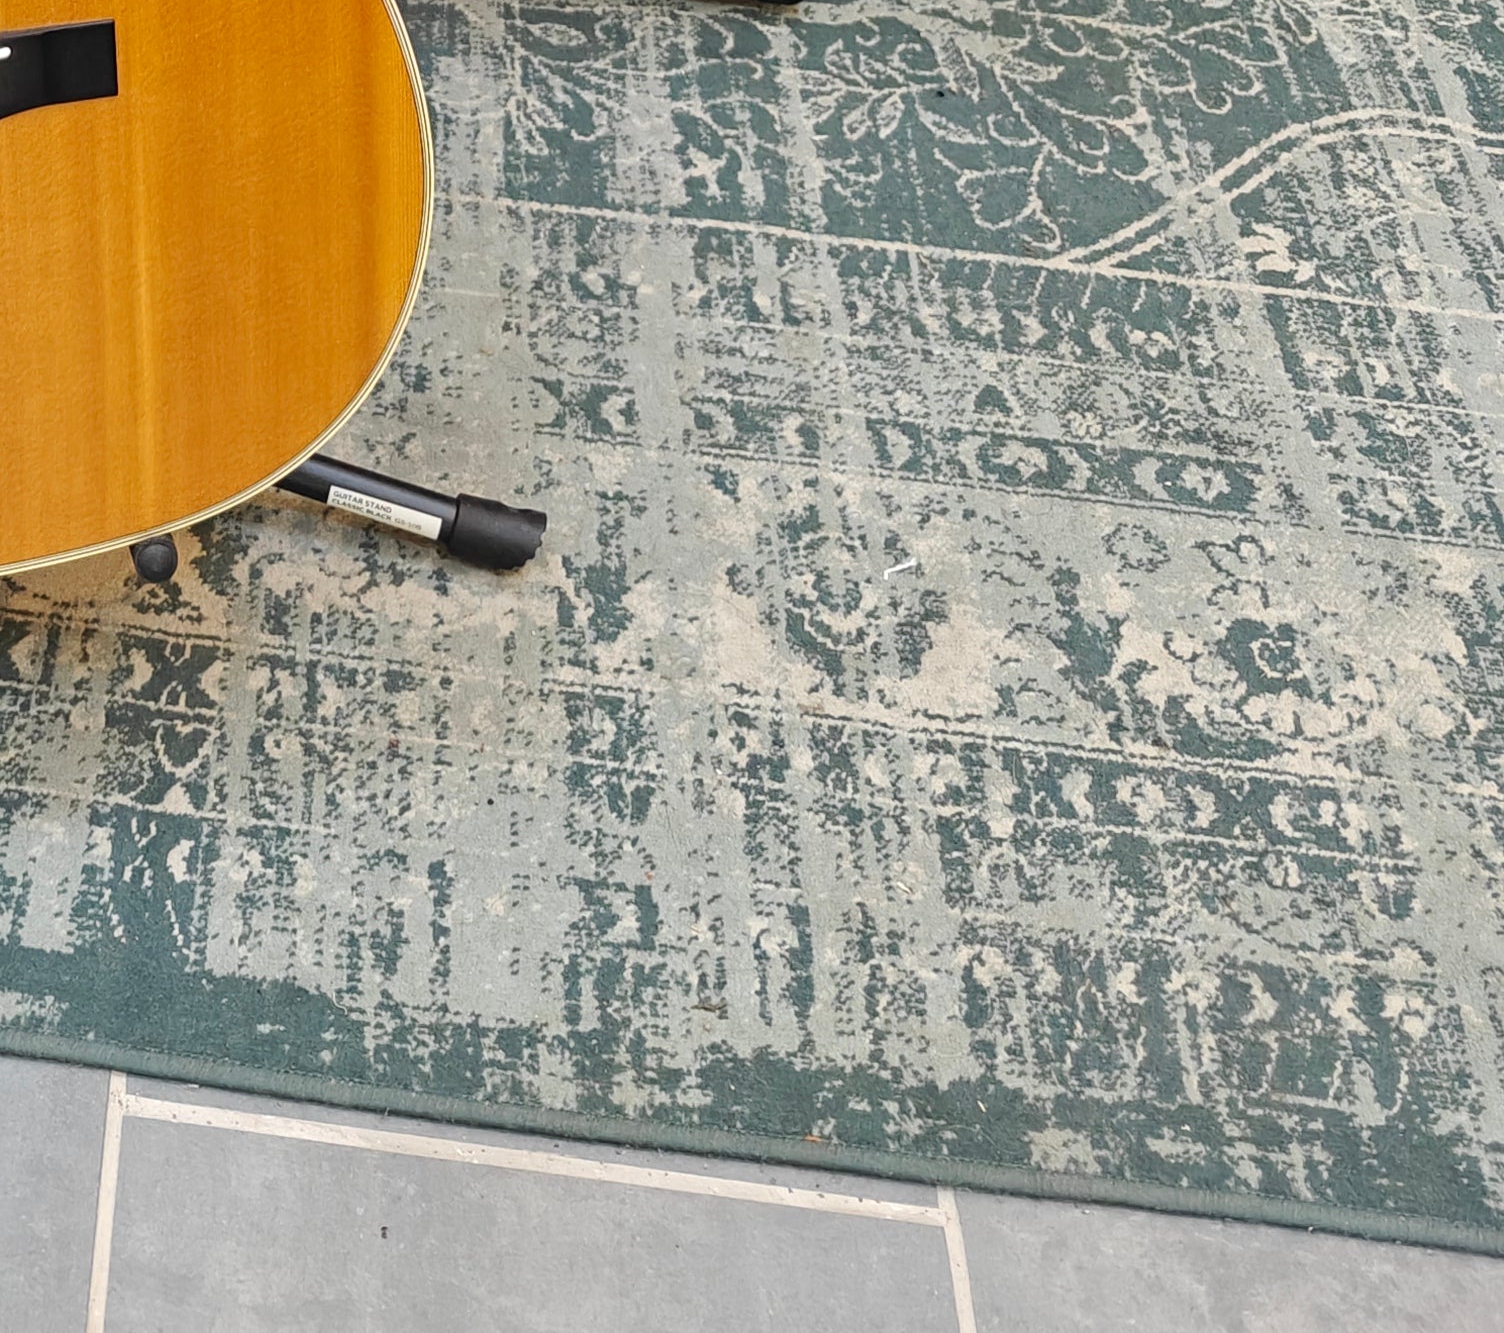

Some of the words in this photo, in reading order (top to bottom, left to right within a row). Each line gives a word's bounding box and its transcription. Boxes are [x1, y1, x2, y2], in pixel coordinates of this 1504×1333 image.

[331, 498, 364, 513] CLASSIC
[365, 508, 393, 523] BLACK
[333, 490, 363, 505] GUITAR
[365, 500, 393, 514] STAND
